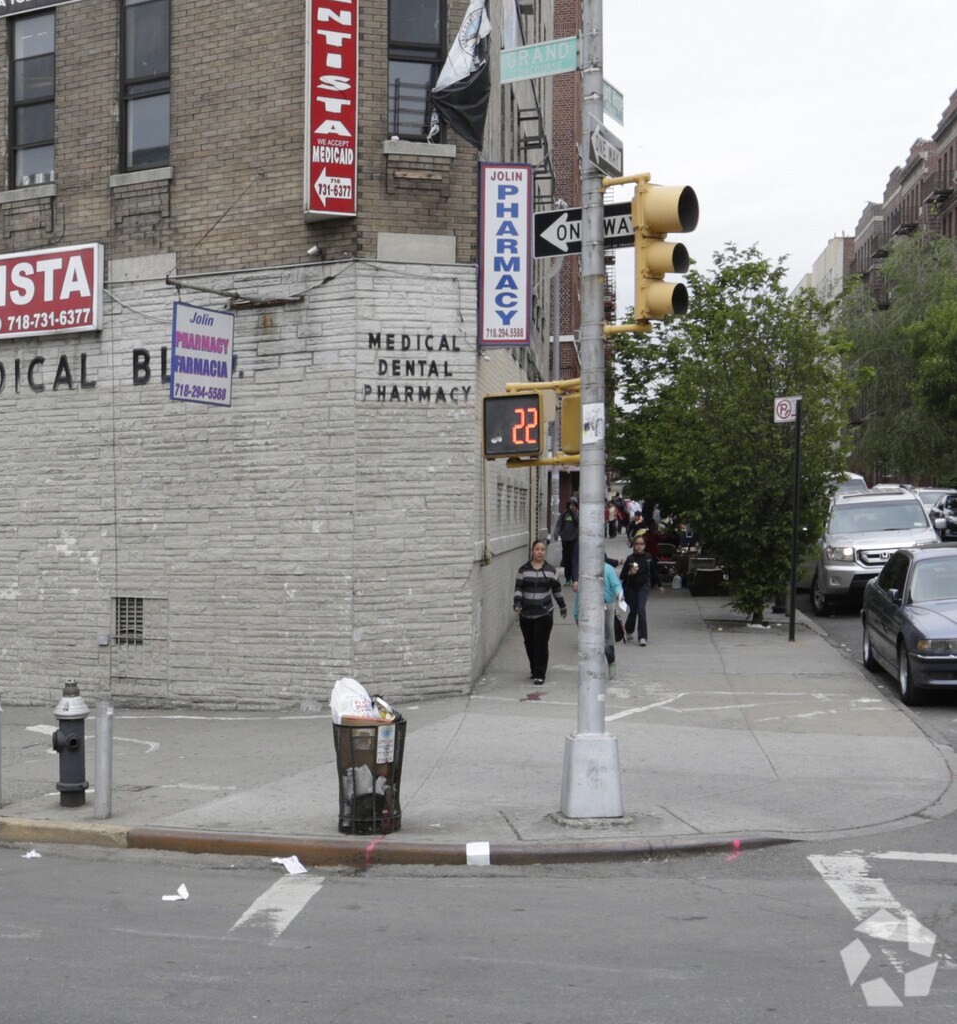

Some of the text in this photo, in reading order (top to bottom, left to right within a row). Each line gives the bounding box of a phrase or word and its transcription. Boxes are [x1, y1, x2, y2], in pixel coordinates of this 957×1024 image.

[507, 42, 570, 69] GRAND
[327, 139, 349, 147] ACCEPT
[595, 134, 621, 169] ONE WAY
[312, 145, 354, 165] MEDICAID
[490, 171, 522, 182] JOLIN
[318, 183, 352, 197] 731-6377
[556, 216, 633, 241] ON WA
[493, 184, 520, 326] PHARMACY
[7, 308, 91, 331] 718-731-6377
[189, 312, 214, 326] Jolin
[175, 331, 229, 355] PHARMACY
[368, 332, 460, 352] MEDICAL
[486, 328, 524, 338] 718.294.5588
[174, 355, 228, 378] FARMACIA
[378, 359, 453, 377] DENTAL
[174, 382, 227, 401] 718-294-5588
[363, 384, 471, 403] PHARMACY
[511, 407, 538, 445] 22
